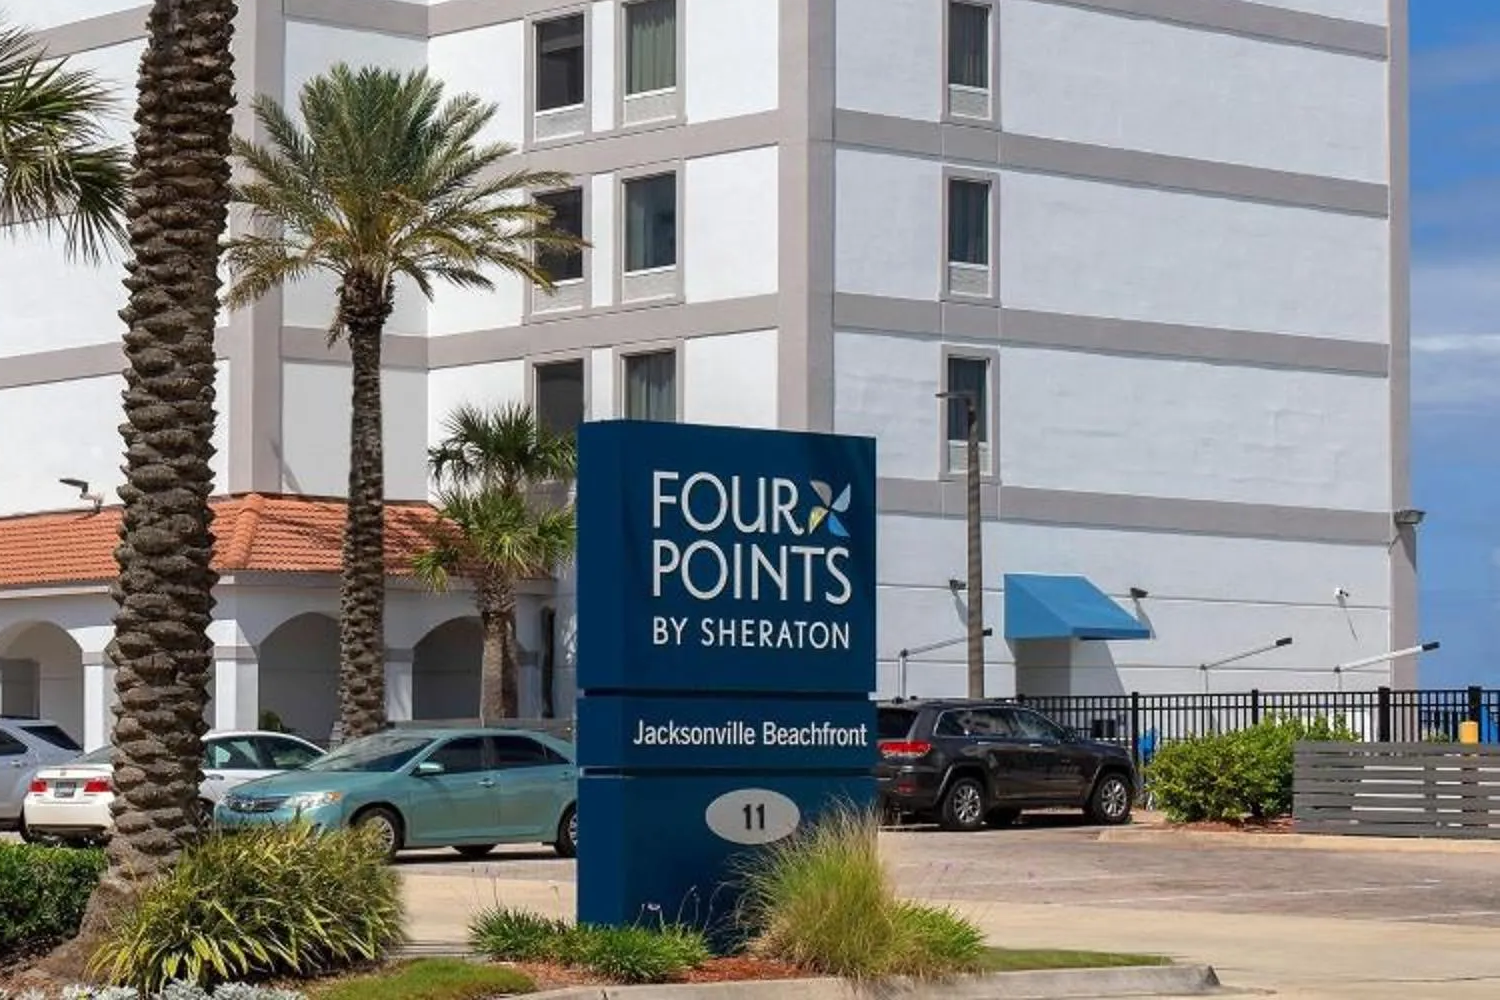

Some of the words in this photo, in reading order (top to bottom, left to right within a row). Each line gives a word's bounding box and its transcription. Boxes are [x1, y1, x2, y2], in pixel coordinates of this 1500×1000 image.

[652, 470, 804, 535] FOUR
[652, 539, 852, 605] POINTS
[653, 617, 688, 646] BY
[701, 618, 850, 649] SHERATON
[633, 719, 756, 746] Jacksonville
[763, 721, 868, 747] Beachfront
[741, 803, 766, 830] 11
